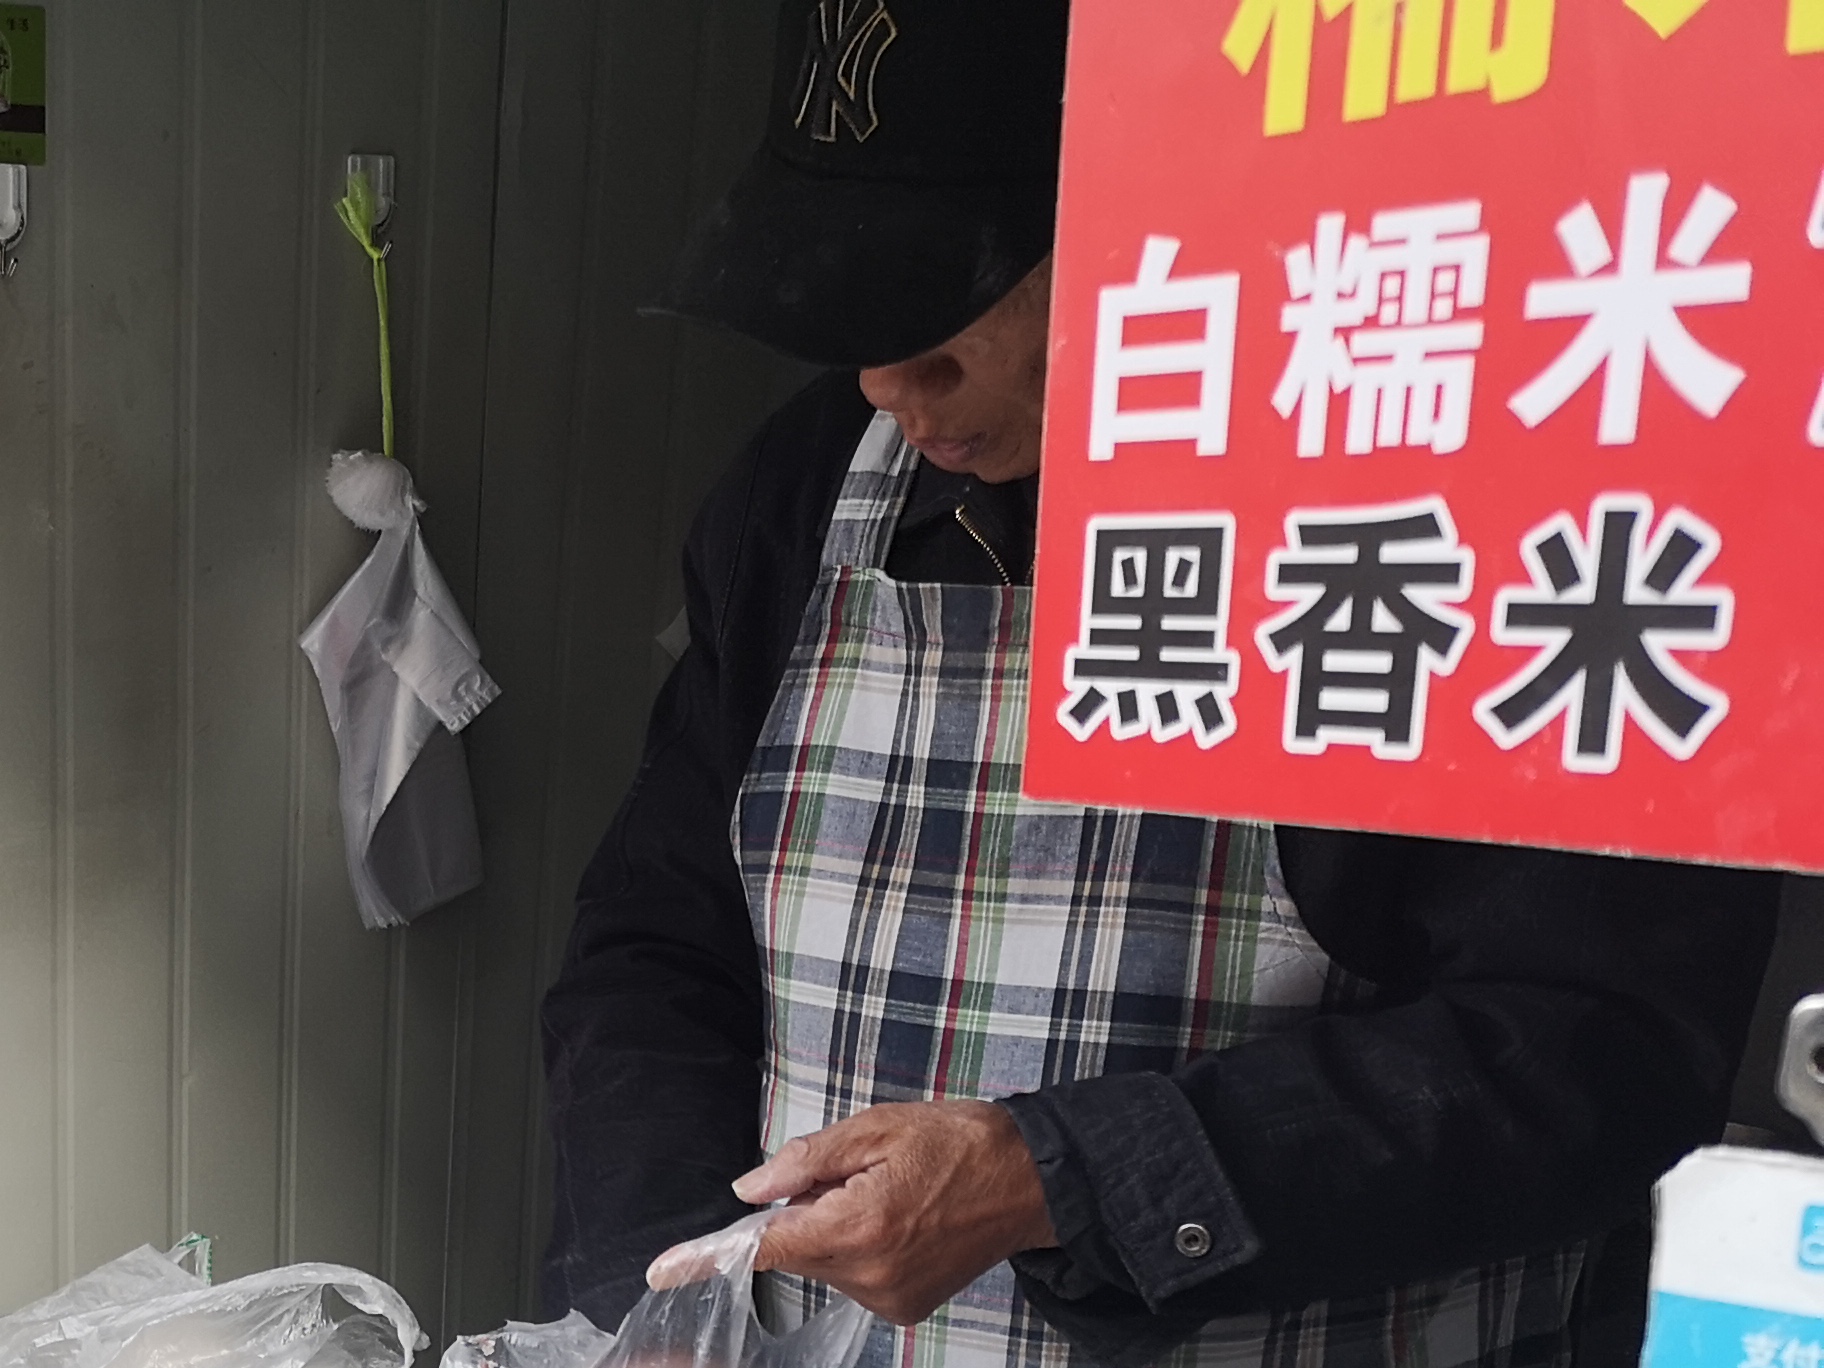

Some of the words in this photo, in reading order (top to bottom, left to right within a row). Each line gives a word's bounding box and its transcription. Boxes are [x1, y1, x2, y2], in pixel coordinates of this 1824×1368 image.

[1088, 171, 1753, 461] 白糯米
[1057, 492, 1736, 773] 黑香米
